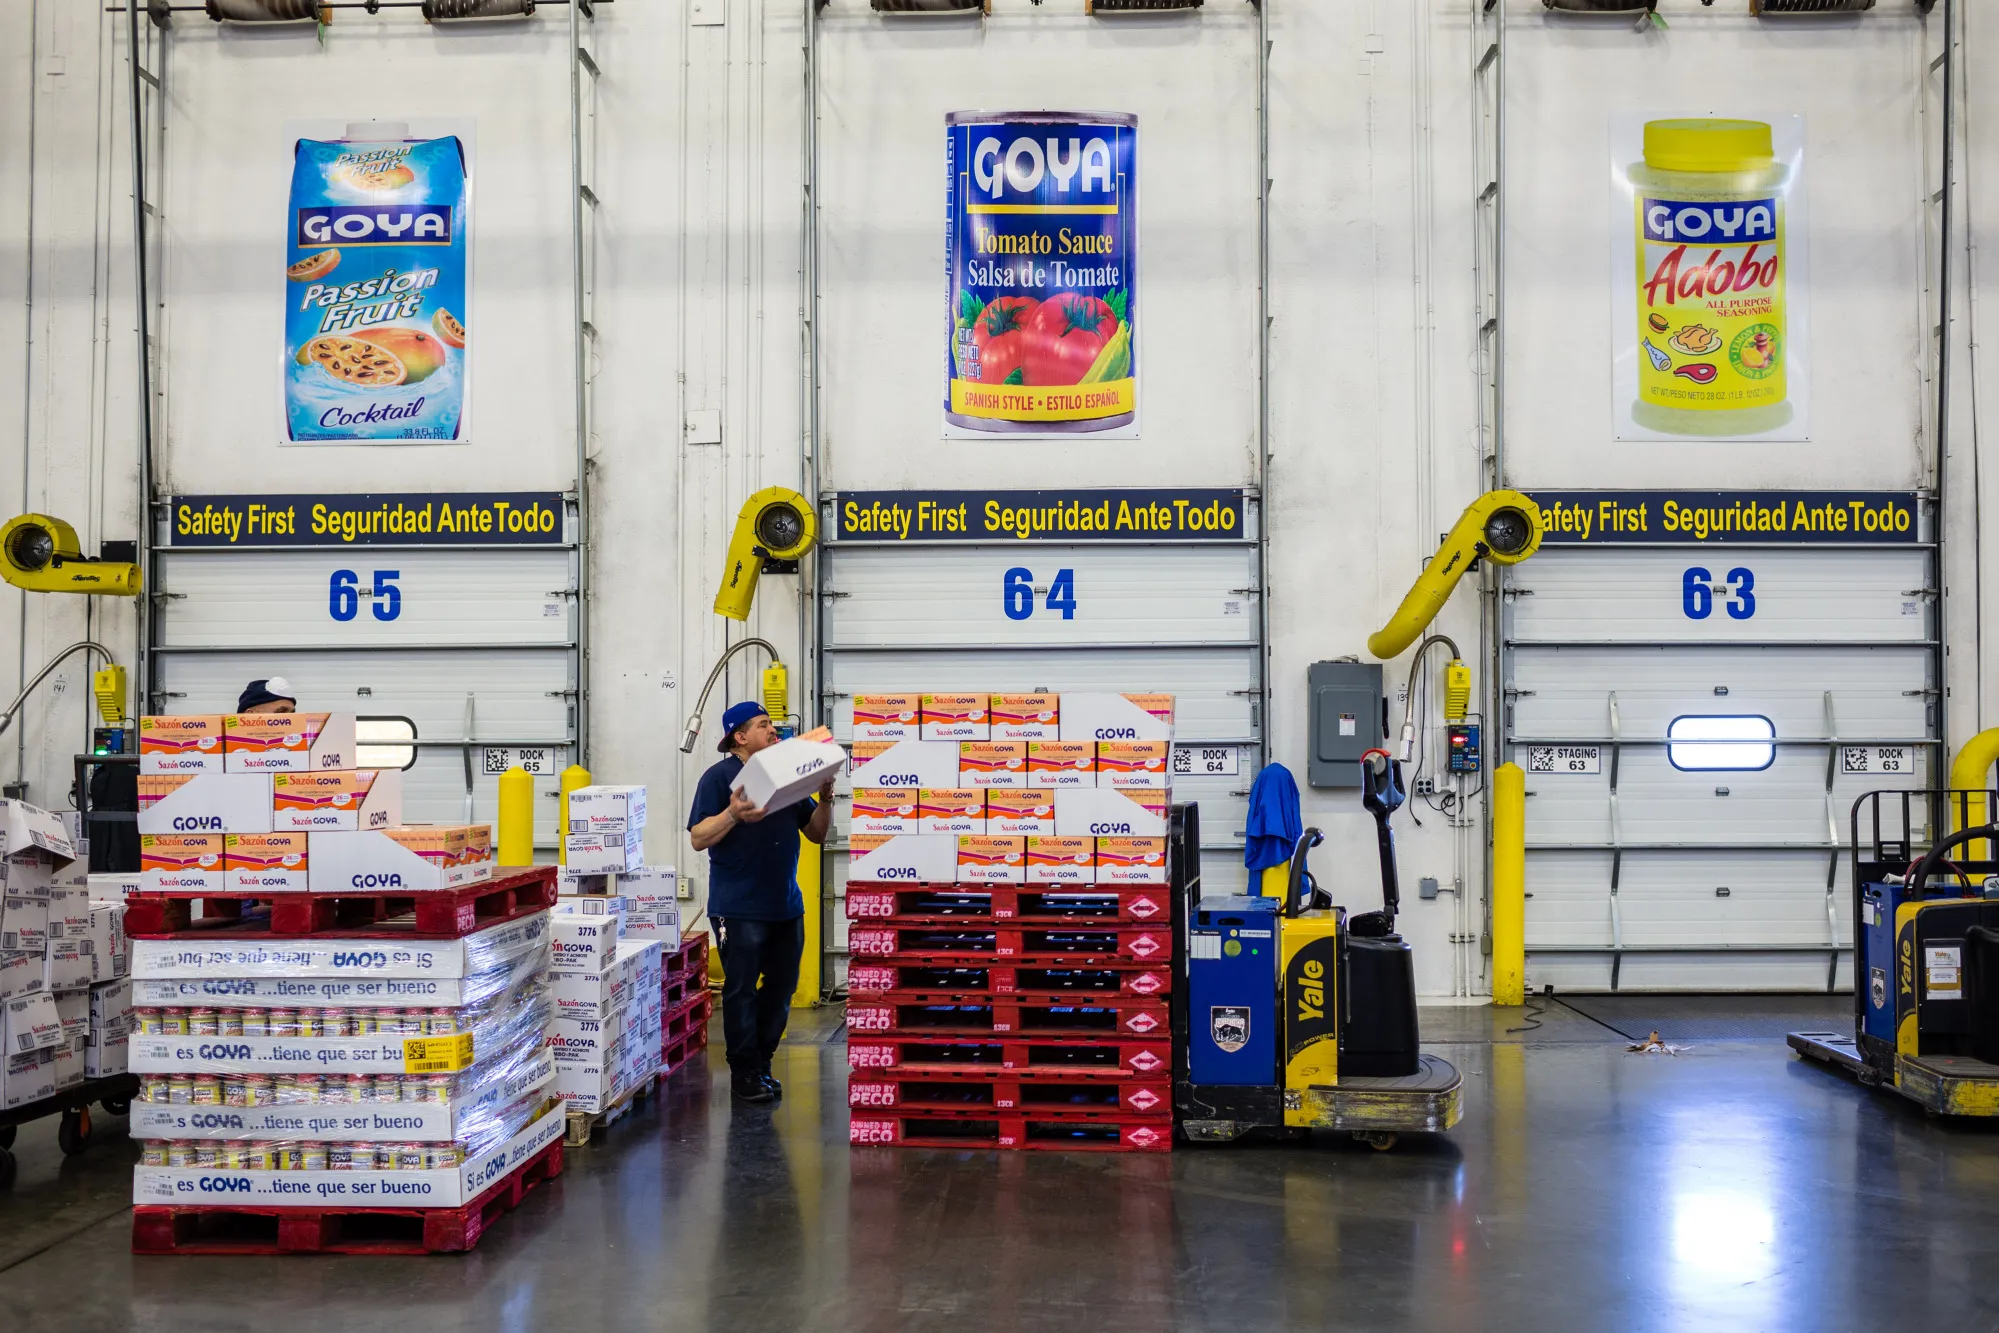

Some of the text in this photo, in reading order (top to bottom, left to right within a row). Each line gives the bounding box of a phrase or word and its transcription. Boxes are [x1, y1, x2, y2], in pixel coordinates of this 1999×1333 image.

[334, 145, 413, 167] Passion
[351, 158, 402, 177] Fruit
[973, 137, 1111, 199] GOYA
[304, 213, 444, 242] GOYA
[1648, 205, 1771, 238] GOYA
[976, 228, 1113, 254] Tomato Sauce
[968, 259, 1120, 288] Salsa de Tomate
[1643, 243, 1777, 308] Adobo
[301, 267, 440, 313] Passion
[1705, 297, 1772, 309] ALL PURPOSE
[319, 294, 424, 334] Fruit
[1716, 306, 1772, 317] SEASONING
[964, 387, 1121, 412] SPANISH STYLE ESTILO ESPAÑOL
[1688, 391, 1704, 400] NETO
[1706, 392, 1714, 400] 28
[319, 397, 426, 429] Cocktail
[178, 502, 555, 542] Safety First Seguridad Ante Todo
[844, 500, 1235, 540] Safety First Seguridad Ante Todo
[1541, 501, 1910, 540] afety First Seguridad Ante Todo
[329, 569, 402, 622] 65
[1003, 567, 1077, 621] 64
[1682, 567, 1756, 621] 63
[661, 681, 675, 689] 140
[865, 695, 886, 705] Sazón
[155, 718, 181, 729] Sazón
[182, 721, 206, 729] GOYA
[936, 728, 953, 736] Sazón
[1095, 728, 1135, 740] GOYA
[520, 750, 544, 760] DOCK
[1203, 749, 1228, 760] DOCK
[1557, 747, 1597, 760] STAGING
[1878, 748, 1904, 760] DOCK
[158, 760, 204, 769] Sazón GOYA
[321, 753, 341, 768] GOYA
[523, 762, 540, 772] 65
[796, 757, 825, 776] GOYA
[1206, 761, 1224, 772] 64
[1569, 760, 1586, 771] 63
[1883, 760, 1900, 771] 63
[879, 774, 919, 787] GOYA
[1040, 776, 1057, 784] Sazón
[1000, 790, 1021, 799] Sazón
[173, 816, 222, 831] GOYA
[370, 811, 388, 826] GOYA
[590, 815, 608, 823] Sazón
[1090, 823, 1131, 835] GOYA
[240, 835, 291, 846] Sazón GOYA
[1109, 837, 1132, 847] Sazón
[877, 867, 917, 879] GOYA
[240, 876, 287, 886] Sazón GOYA
[352, 873, 402, 889] GOYA
[850, 895, 893, 904] OWNED BY
[848, 903, 893, 917] PECO
[457, 913, 475, 932] PECO
[578, 926, 597, 937] 3776
[563, 943, 593, 953] GOYA
[207, 952, 231, 964] ser
[238, 947, 268, 963] que
[333, 951, 387, 969] GOYA
[393, 952, 411, 964] es
[417, 952, 433, 968] Si
[1901, 938, 1911, 995] Yale
[180, 982, 197, 995] es
[203, 979, 256, 995] GOYA
[321, 982, 350, 999] que
[357, 982, 382, 995] ser
[1298, 959, 1325, 1021] Yale
[558, 998, 579, 1007] Sazón
[847, 1008, 890, 1017] OWNED BY
[580, 1021, 600, 1032] 3776
[847, 1017, 890, 1030] PECO
[565, 1038, 595, 1048] GOYA
[176, 1047, 194, 1060] es
[200, 1044, 252, 1061] GOYA
[317, 1048, 347, 1065] que
[352, 1048, 377, 1061] ser
[851, 1084, 895, 1093] OWNED BY
[850, 1093, 895, 1106] PECO
[850, 1121, 894, 1129] OWNED BY
[850, 1129, 893, 1142] PECO
[467, 1171, 475, 1192] Si
[476, 1171, 484, 1185] es
[486, 1152, 506, 1180] GOYA
[526, 1141, 536, 1157] que
[538, 1133, 546, 1146] ser
[546, 1118, 561, 1137] bueno
[177, 1176, 432, 1197] es GOYA ...tiene que ser bueno
